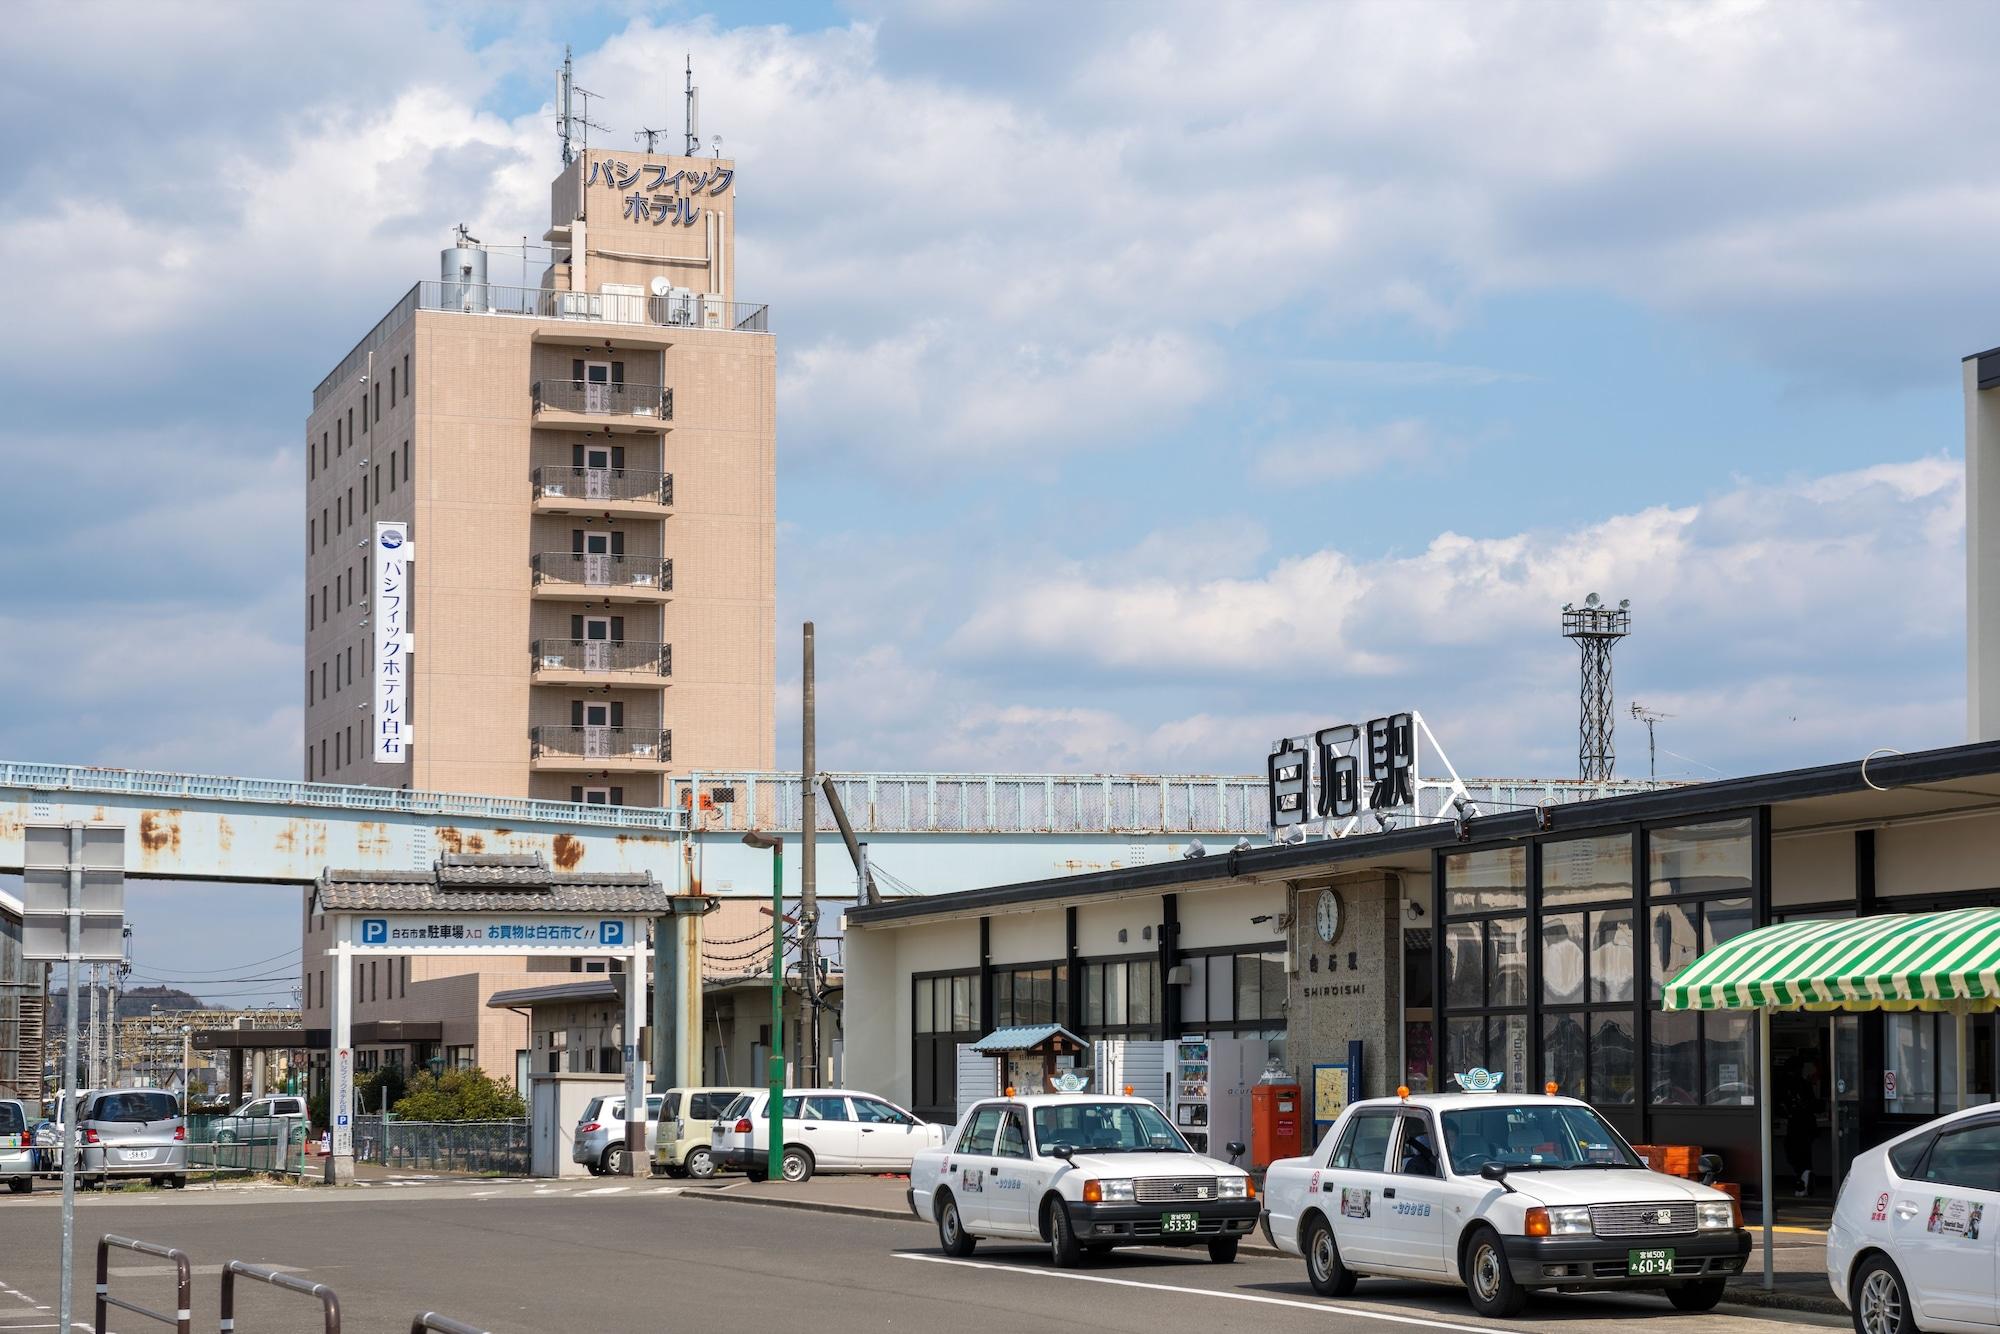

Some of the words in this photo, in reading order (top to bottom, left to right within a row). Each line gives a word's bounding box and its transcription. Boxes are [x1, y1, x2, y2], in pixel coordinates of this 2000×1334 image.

[586, 158, 734, 197] パシフィック
[623, 191, 701, 226] ホテル
[381, 559, 402, 754] パシフィックホテル白石
[465, 929, 482, 939] 入口
[1303, 984, 1366, 998] SHIROISHI
[1227, 1088, 1253, 1096] acur
[1658, 1210, 1671, 1219] JR
[1169, 1220, 1197, 1232] 53-39
[1638, 1259, 1673, 1273] 60-94
